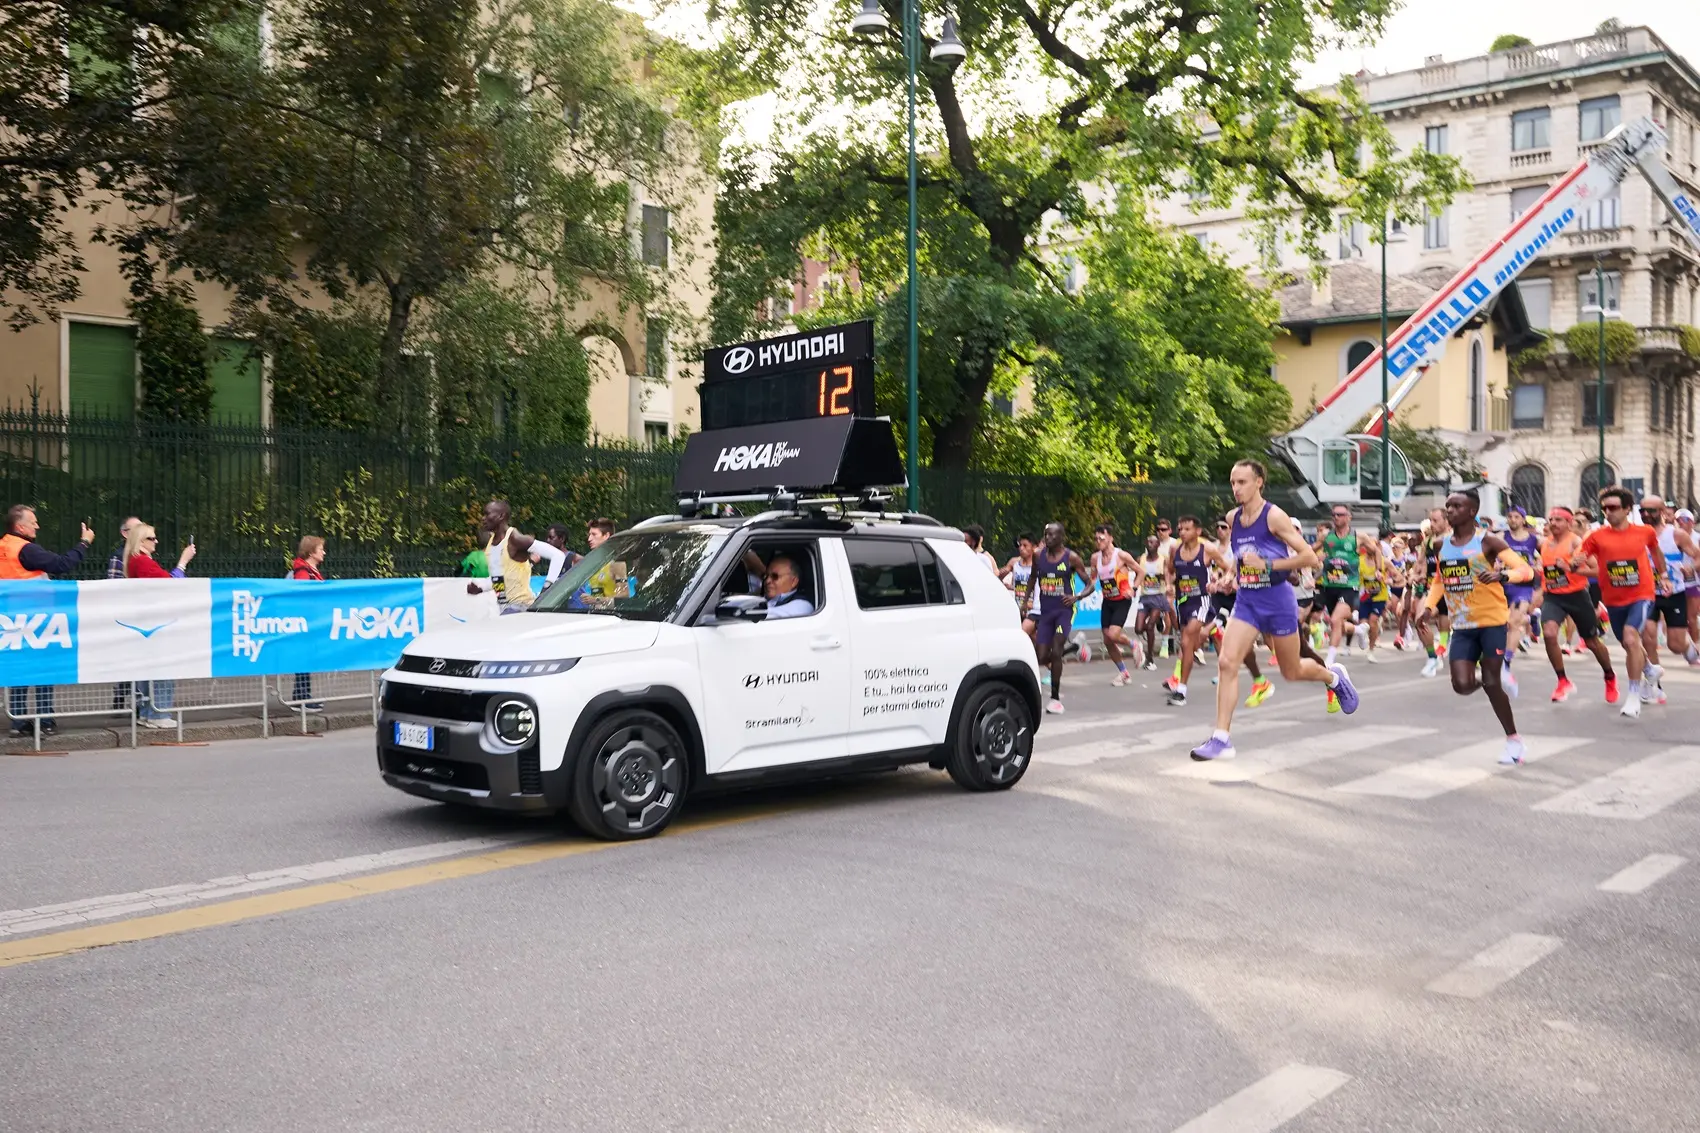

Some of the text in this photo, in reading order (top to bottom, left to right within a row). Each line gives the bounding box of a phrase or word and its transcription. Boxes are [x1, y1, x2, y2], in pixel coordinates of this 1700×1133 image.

[759, 332, 845, 367] HYUNDAI
[819, 366, 853, 415] 12
[713, 443, 773, 472] HOKA
[232, 590, 264, 617] Fly
[232, 612, 308, 634] Human
[329, 606, 420, 640] HOKA
[232, 634, 265, 662] Fly
[766, 671, 819, 685] HYUNDAI
[864, 666, 929, 680] 100% elettrica
[864, 687, 870, 697] E
[890, 683, 905, 695] hai
[906, 681, 916, 693] la
[917, 682, 948, 693] carica
[863, 697, 945, 717] per starmi dietro?
[745, 716, 802, 729] Stramilano
